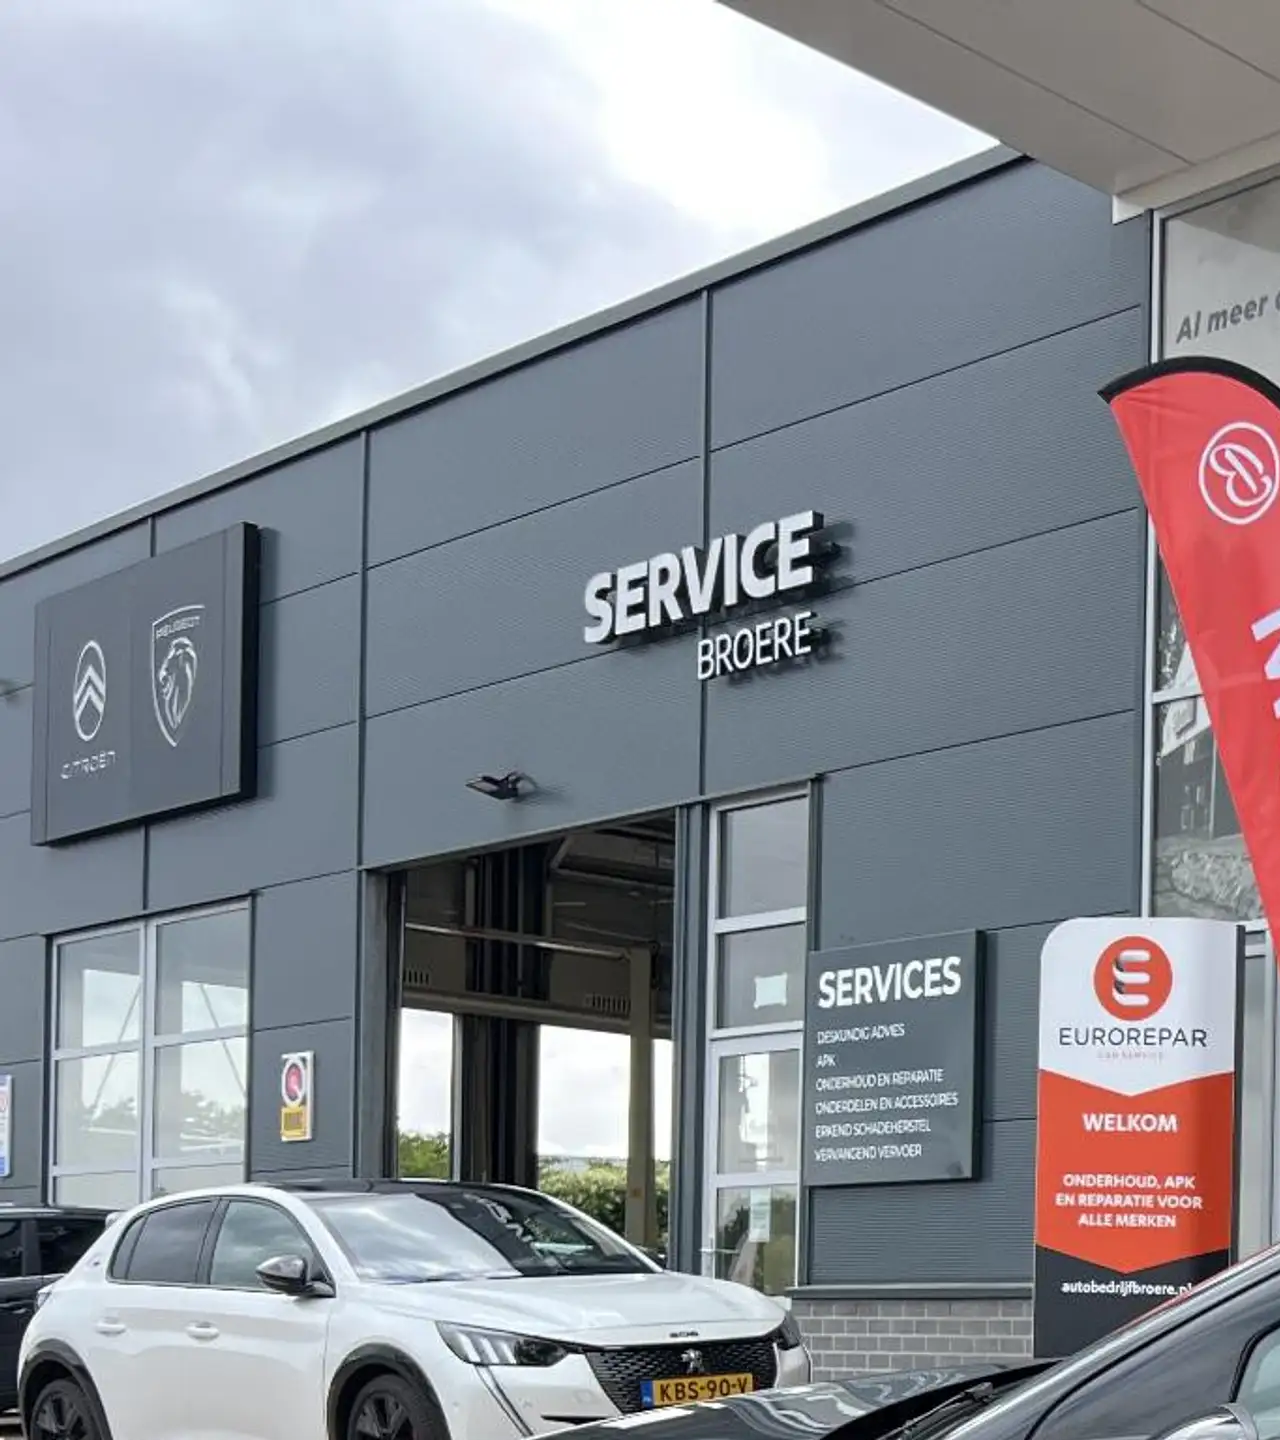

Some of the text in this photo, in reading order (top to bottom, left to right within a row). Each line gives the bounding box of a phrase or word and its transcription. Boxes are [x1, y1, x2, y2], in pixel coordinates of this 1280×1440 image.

[1176, 310, 1202, 344] Al
[1207, 293, 1268, 334] meer
[584, 510, 816, 643] SERVICE
[697, 611, 812, 680] BROERE
[818, 956, 961, 1008] SERVICES
[817, 1023, 905, 1044] DESKUNDIG ADVIES
[1059, 1027, 1207, 1047] EUROREPAR
[815, 1053, 837, 1067] APK
[815, 1069, 944, 1091] ONDERHOUD EN REPARATIE
[815, 1092, 959, 1115] ONDERDELEN EN ACCESSOIRES
[815, 1119, 931, 1138] ERKEND SCHADEHERSTEL
[1082, 1113, 1178, 1132] WELKOM
[878, 1143, 922, 1159] VERVOER
[1063, 1174, 1196, 1190] ONDERHOUD, APK
[1055, 1193, 1203, 1209] EN REPARATIE VOOR
[1077, 1213, 1177, 1228] ALLE MERKEN
[659, 1377, 748, 1403] KBS-90-V
